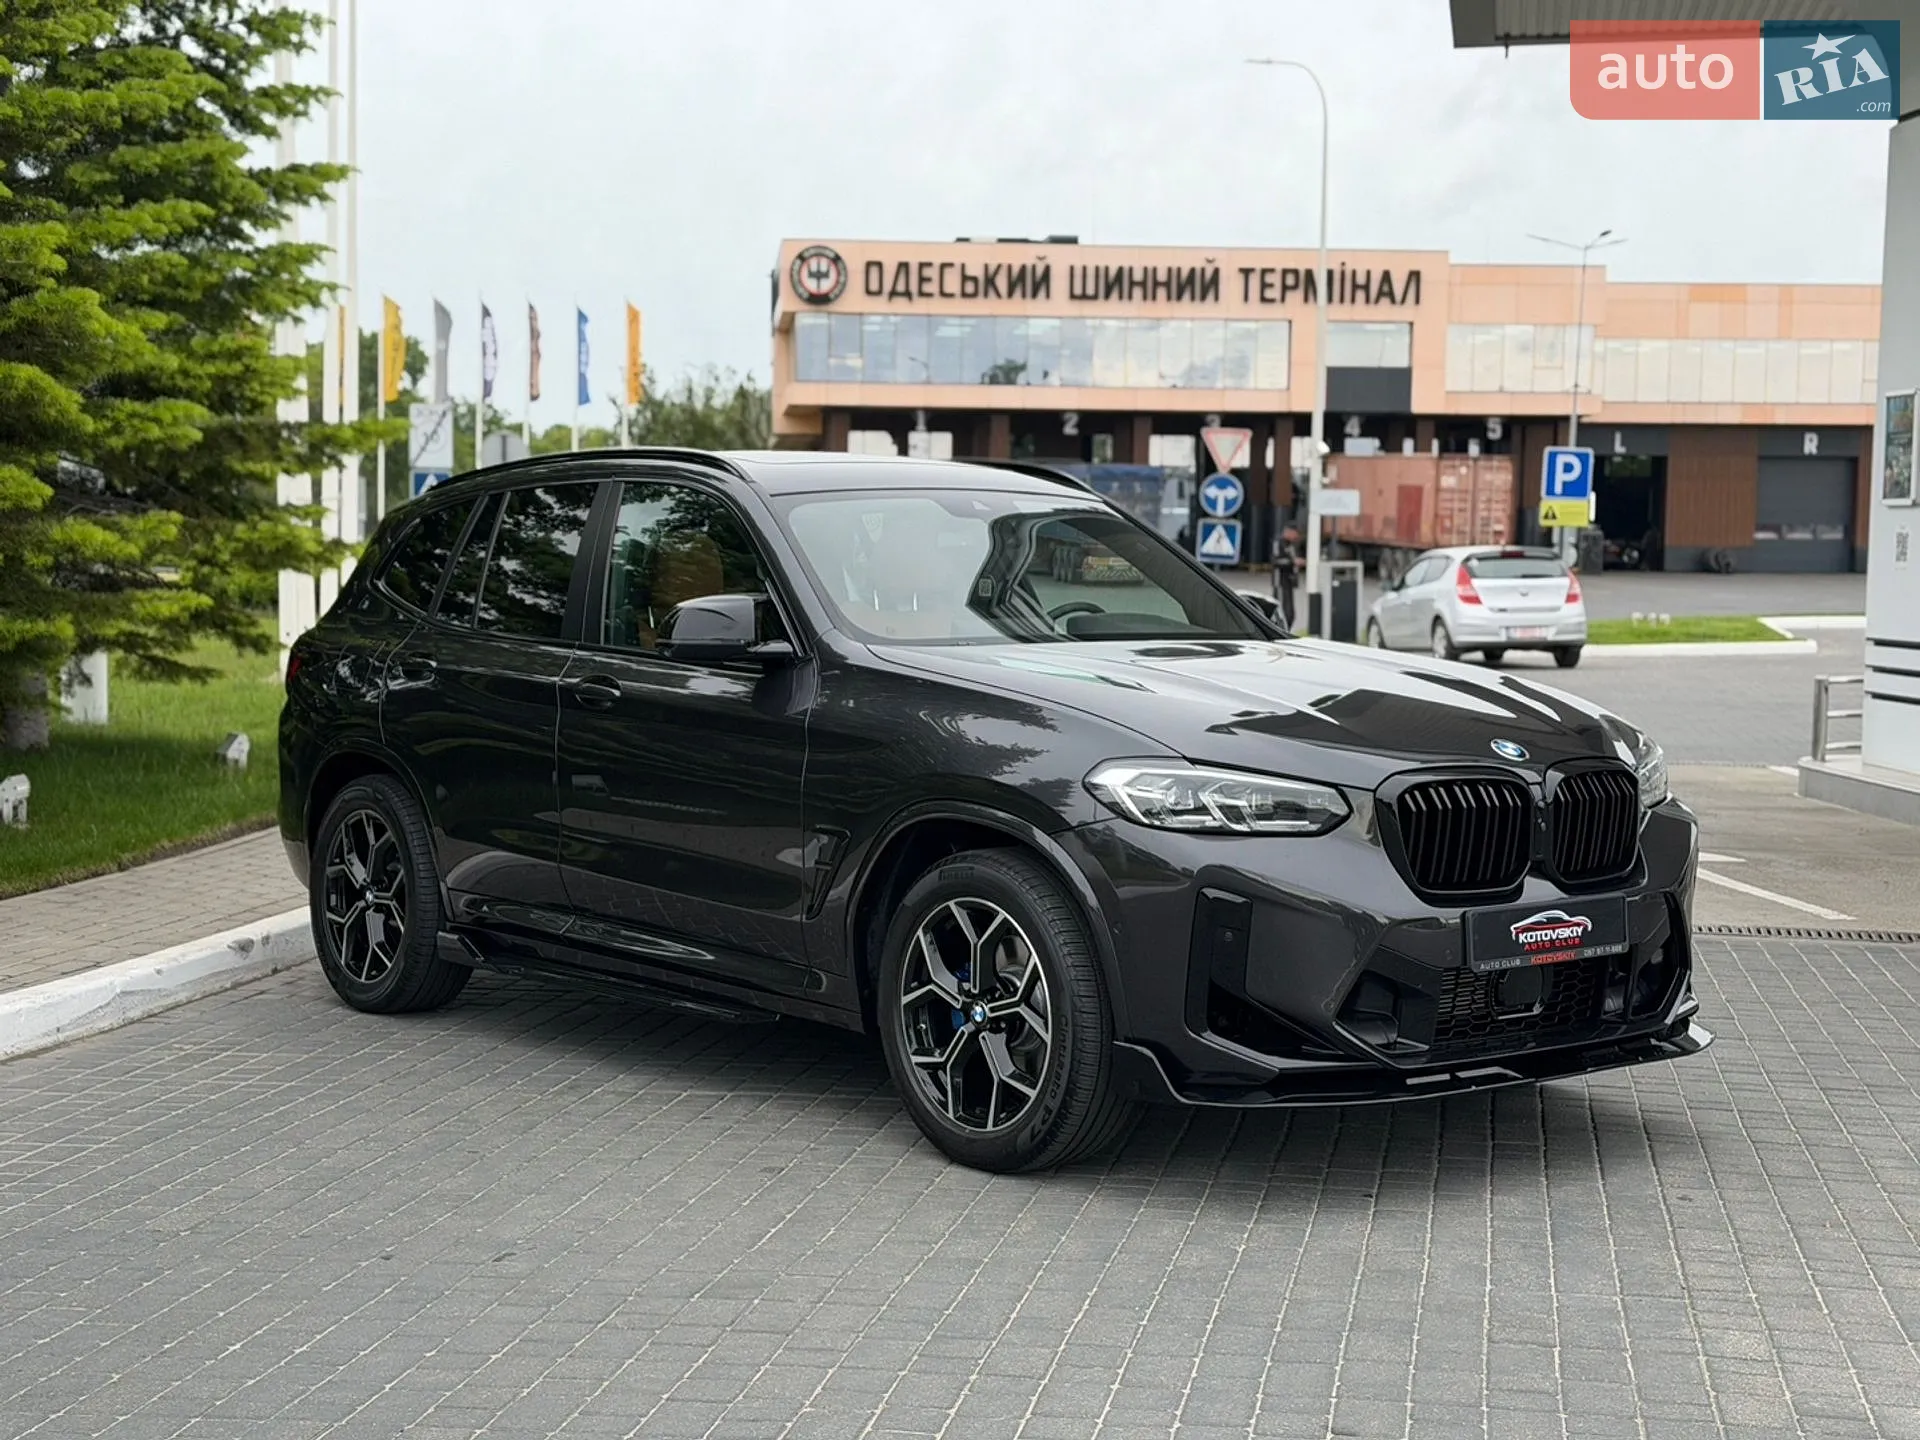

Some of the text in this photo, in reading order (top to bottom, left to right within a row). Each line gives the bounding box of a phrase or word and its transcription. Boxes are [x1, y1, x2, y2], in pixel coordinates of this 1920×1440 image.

[863, 256, 1051, 301] ОДЕСЬКИЙ
[1068, 258, 1221, 304] ШИННИЙ
[1238, 261, 1422, 305] ТЕРМІНАЛ
[1062, 412, 1079, 436] 2
[1344, 415, 1361, 437] 4
[1486, 417, 1502, 440] 5
[1614, 431, 1627, 454] L
[1803, 431, 1818, 456] R
[1554, 453, 1583, 495] P
[1518, 926, 1584, 944] KOTOVSKIY
[1524, 937, 1581, 951] AUTO CLUB
[1480, 961, 1500, 970] AUTO
[1501, 958, 1521, 968] CLUB
